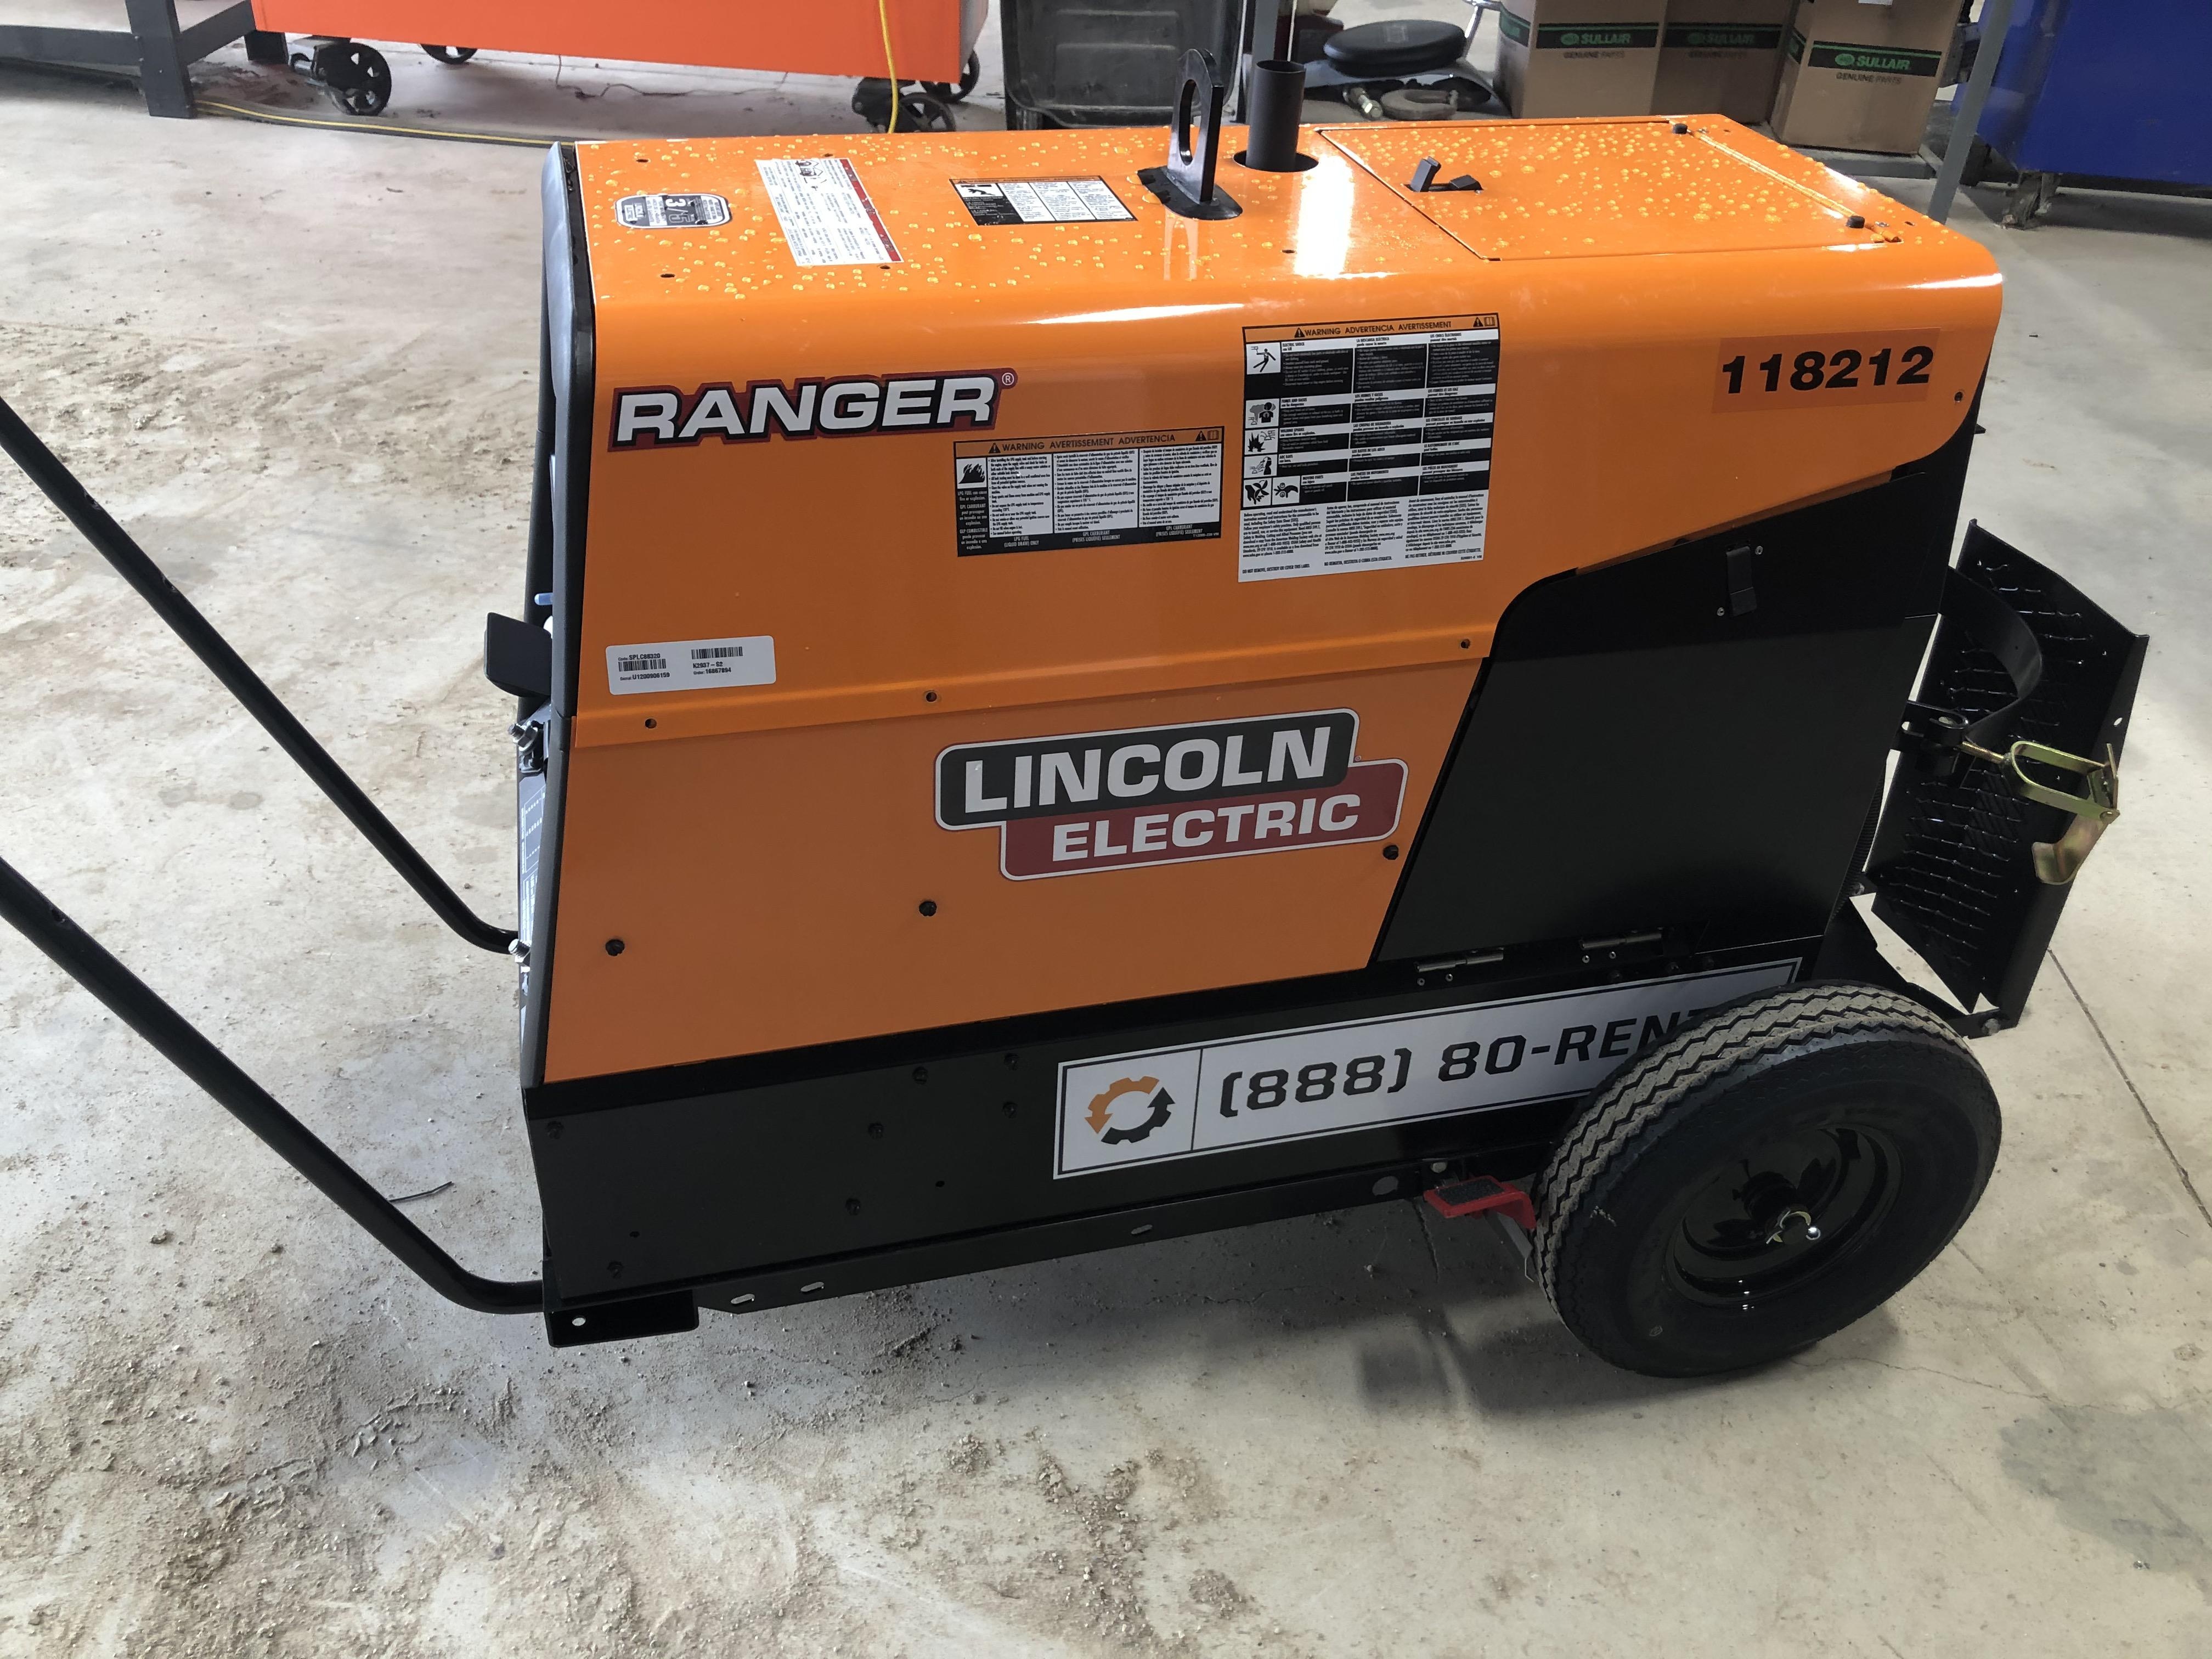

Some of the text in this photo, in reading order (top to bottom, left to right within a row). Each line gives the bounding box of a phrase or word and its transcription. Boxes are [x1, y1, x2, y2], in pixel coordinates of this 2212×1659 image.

[1581, 33, 1630, 44] SULLAIR
[1706, 33, 1754, 44] SULLAIR
[1858, 55, 1910, 70] SULLAIR
[1305, 320, 1452, 336] WARNING ADVERTENCIA AVERTISSEMENT
[1723, 345, 1933, 394] 118212
[1002, 434, 1175, 451] WARNING AVERTISSEMENT ADVERTENCIA
[964, 726, 1331, 814] LINCOLN
[1052, 794, 1361, 862] ELECTRIC
[1218, 1008, 1711, 1118] (888) 80-REN
